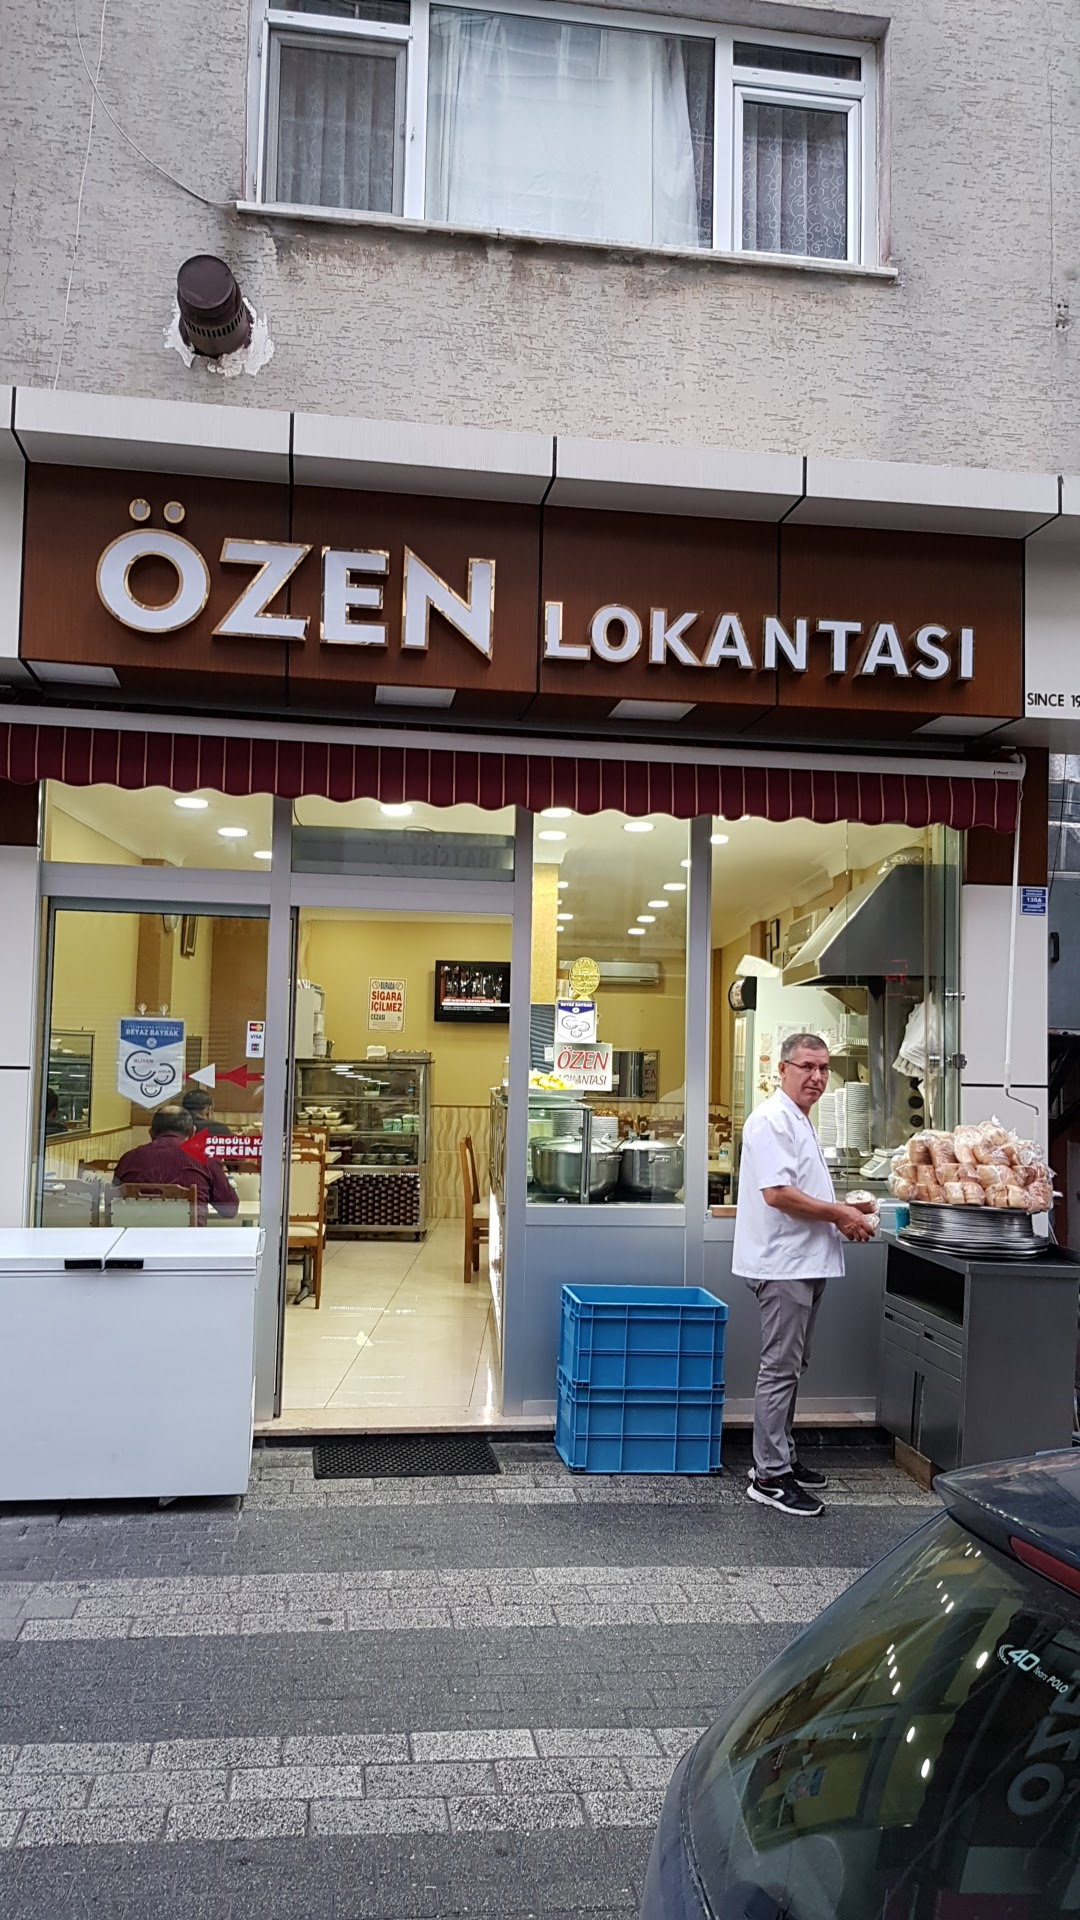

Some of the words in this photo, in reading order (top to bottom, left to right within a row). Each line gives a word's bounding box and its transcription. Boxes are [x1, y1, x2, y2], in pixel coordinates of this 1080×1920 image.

[96, 498, 497, 662] ÖZEN
[543, 601, 976, 681] LOKANTASI
[1027, 692, 1065, 707] SINCE
[371, 991, 402, 1001] SİGARA
[125, 1028, 149, 1036] BEYAZ
[149, 1029, 179, 1037] BAYRAK
[556, 1046, 609, 1070] ÖZEN
[206, 1136, 251, 1145] SÜRGÜLÜ
[1008, 1649, 1041, 1671] 40
[1033, 1665, 1049, 1681] Years
[1046, 1675, 1069, 1693] POLO
